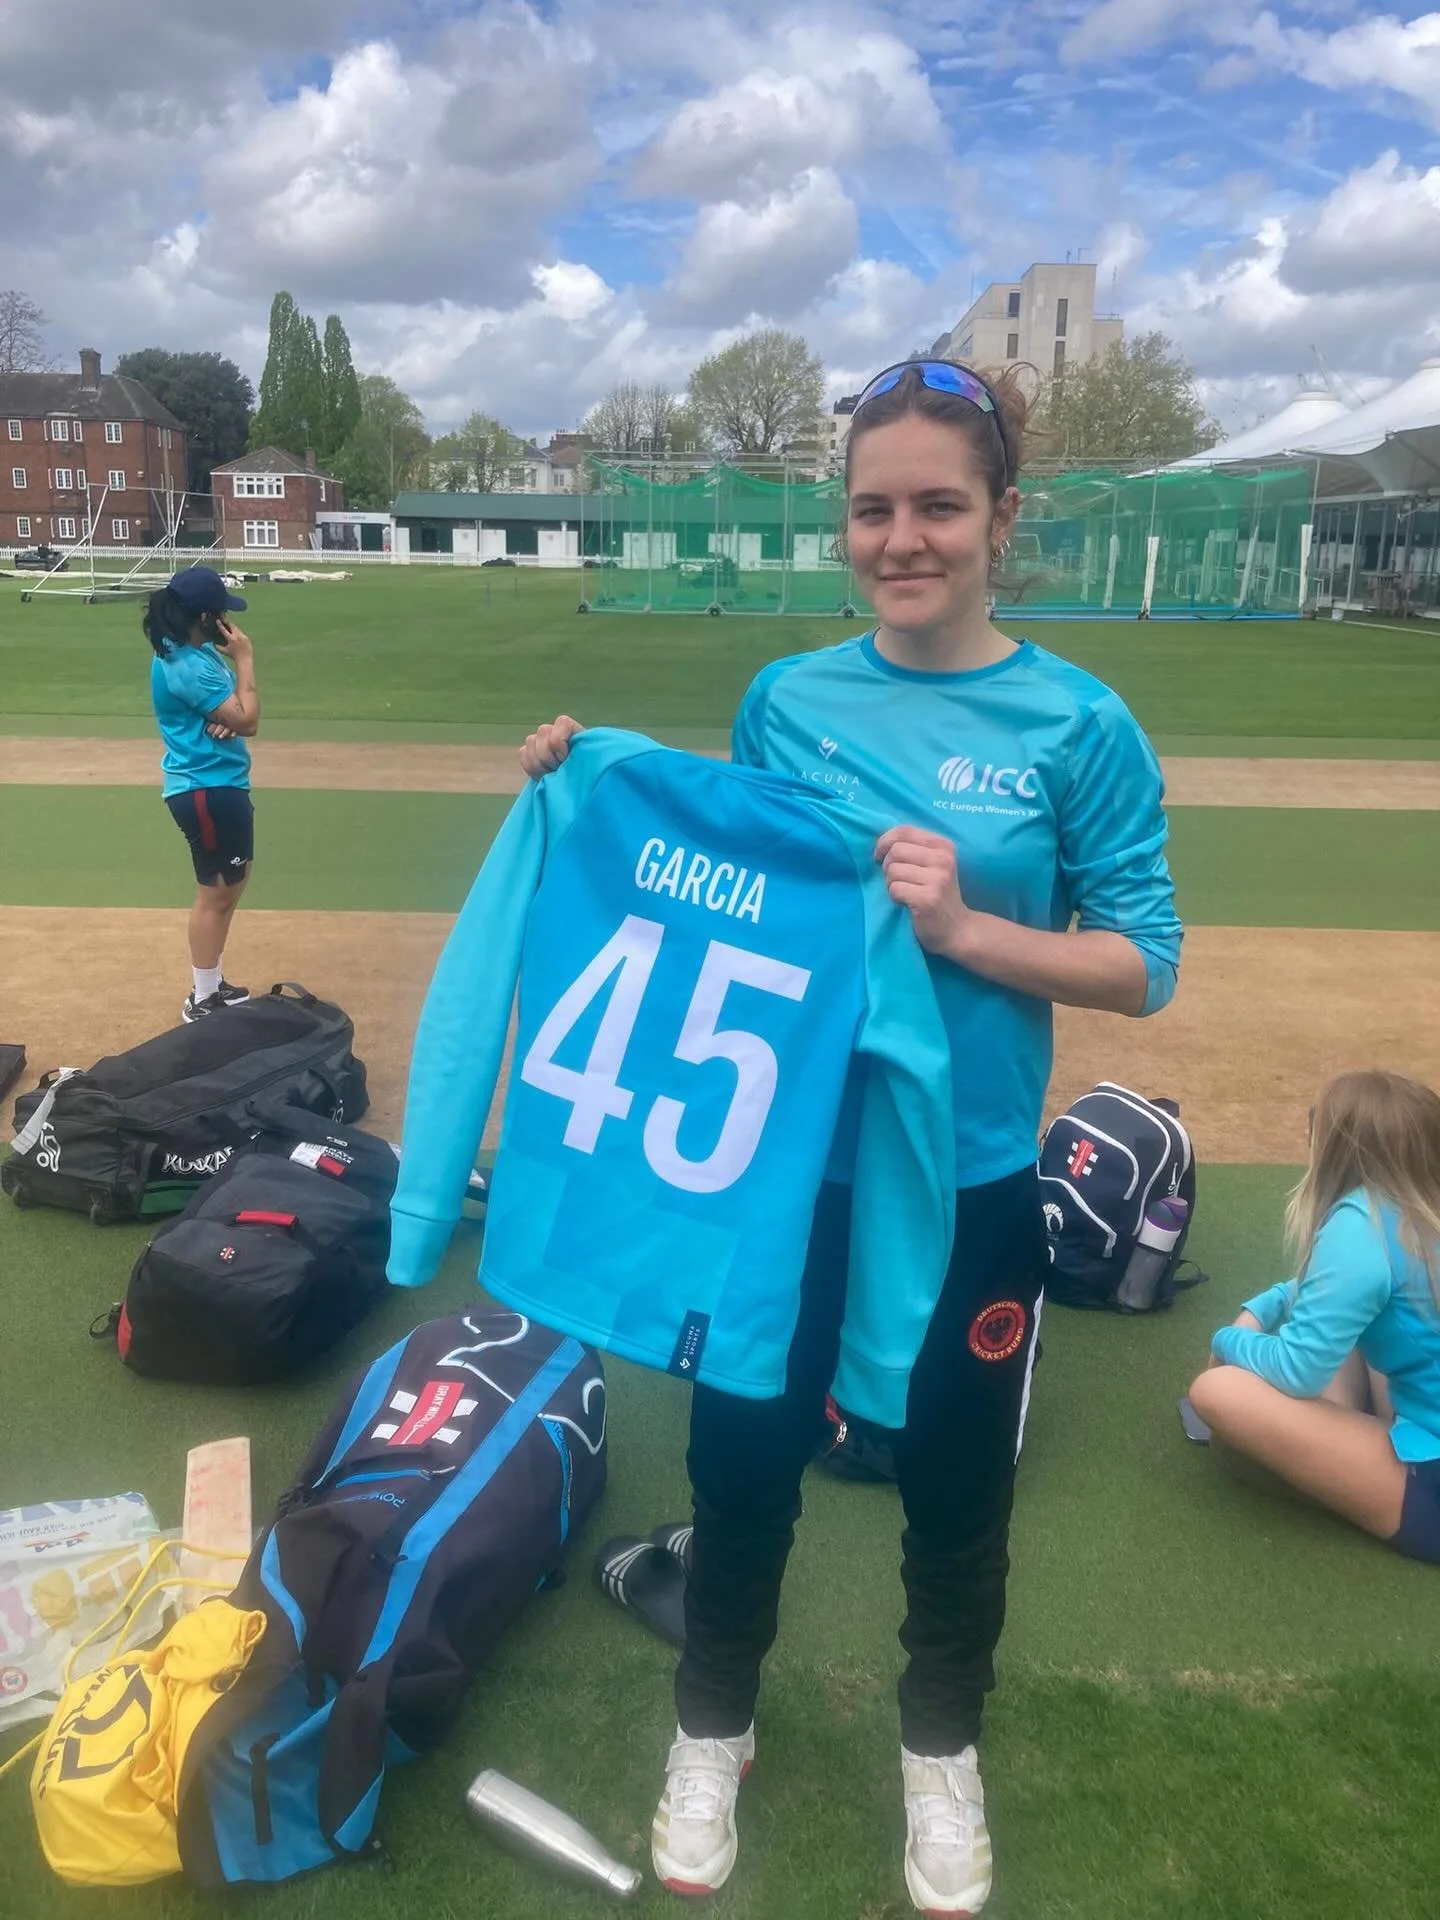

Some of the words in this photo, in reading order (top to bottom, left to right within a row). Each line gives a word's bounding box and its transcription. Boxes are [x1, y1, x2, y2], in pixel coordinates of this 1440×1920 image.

[977, 763, 1037, 799] ICC
[932, 799, 949, 809] ICC
[950, 802, 984, 813] Europe
[985, 805, 1027, 817] Women's
[634, 837, 767, 923] GARCIA
[520, 913, 812, 1193] 45
[1006, 1328, 1023, 1353] BUND
